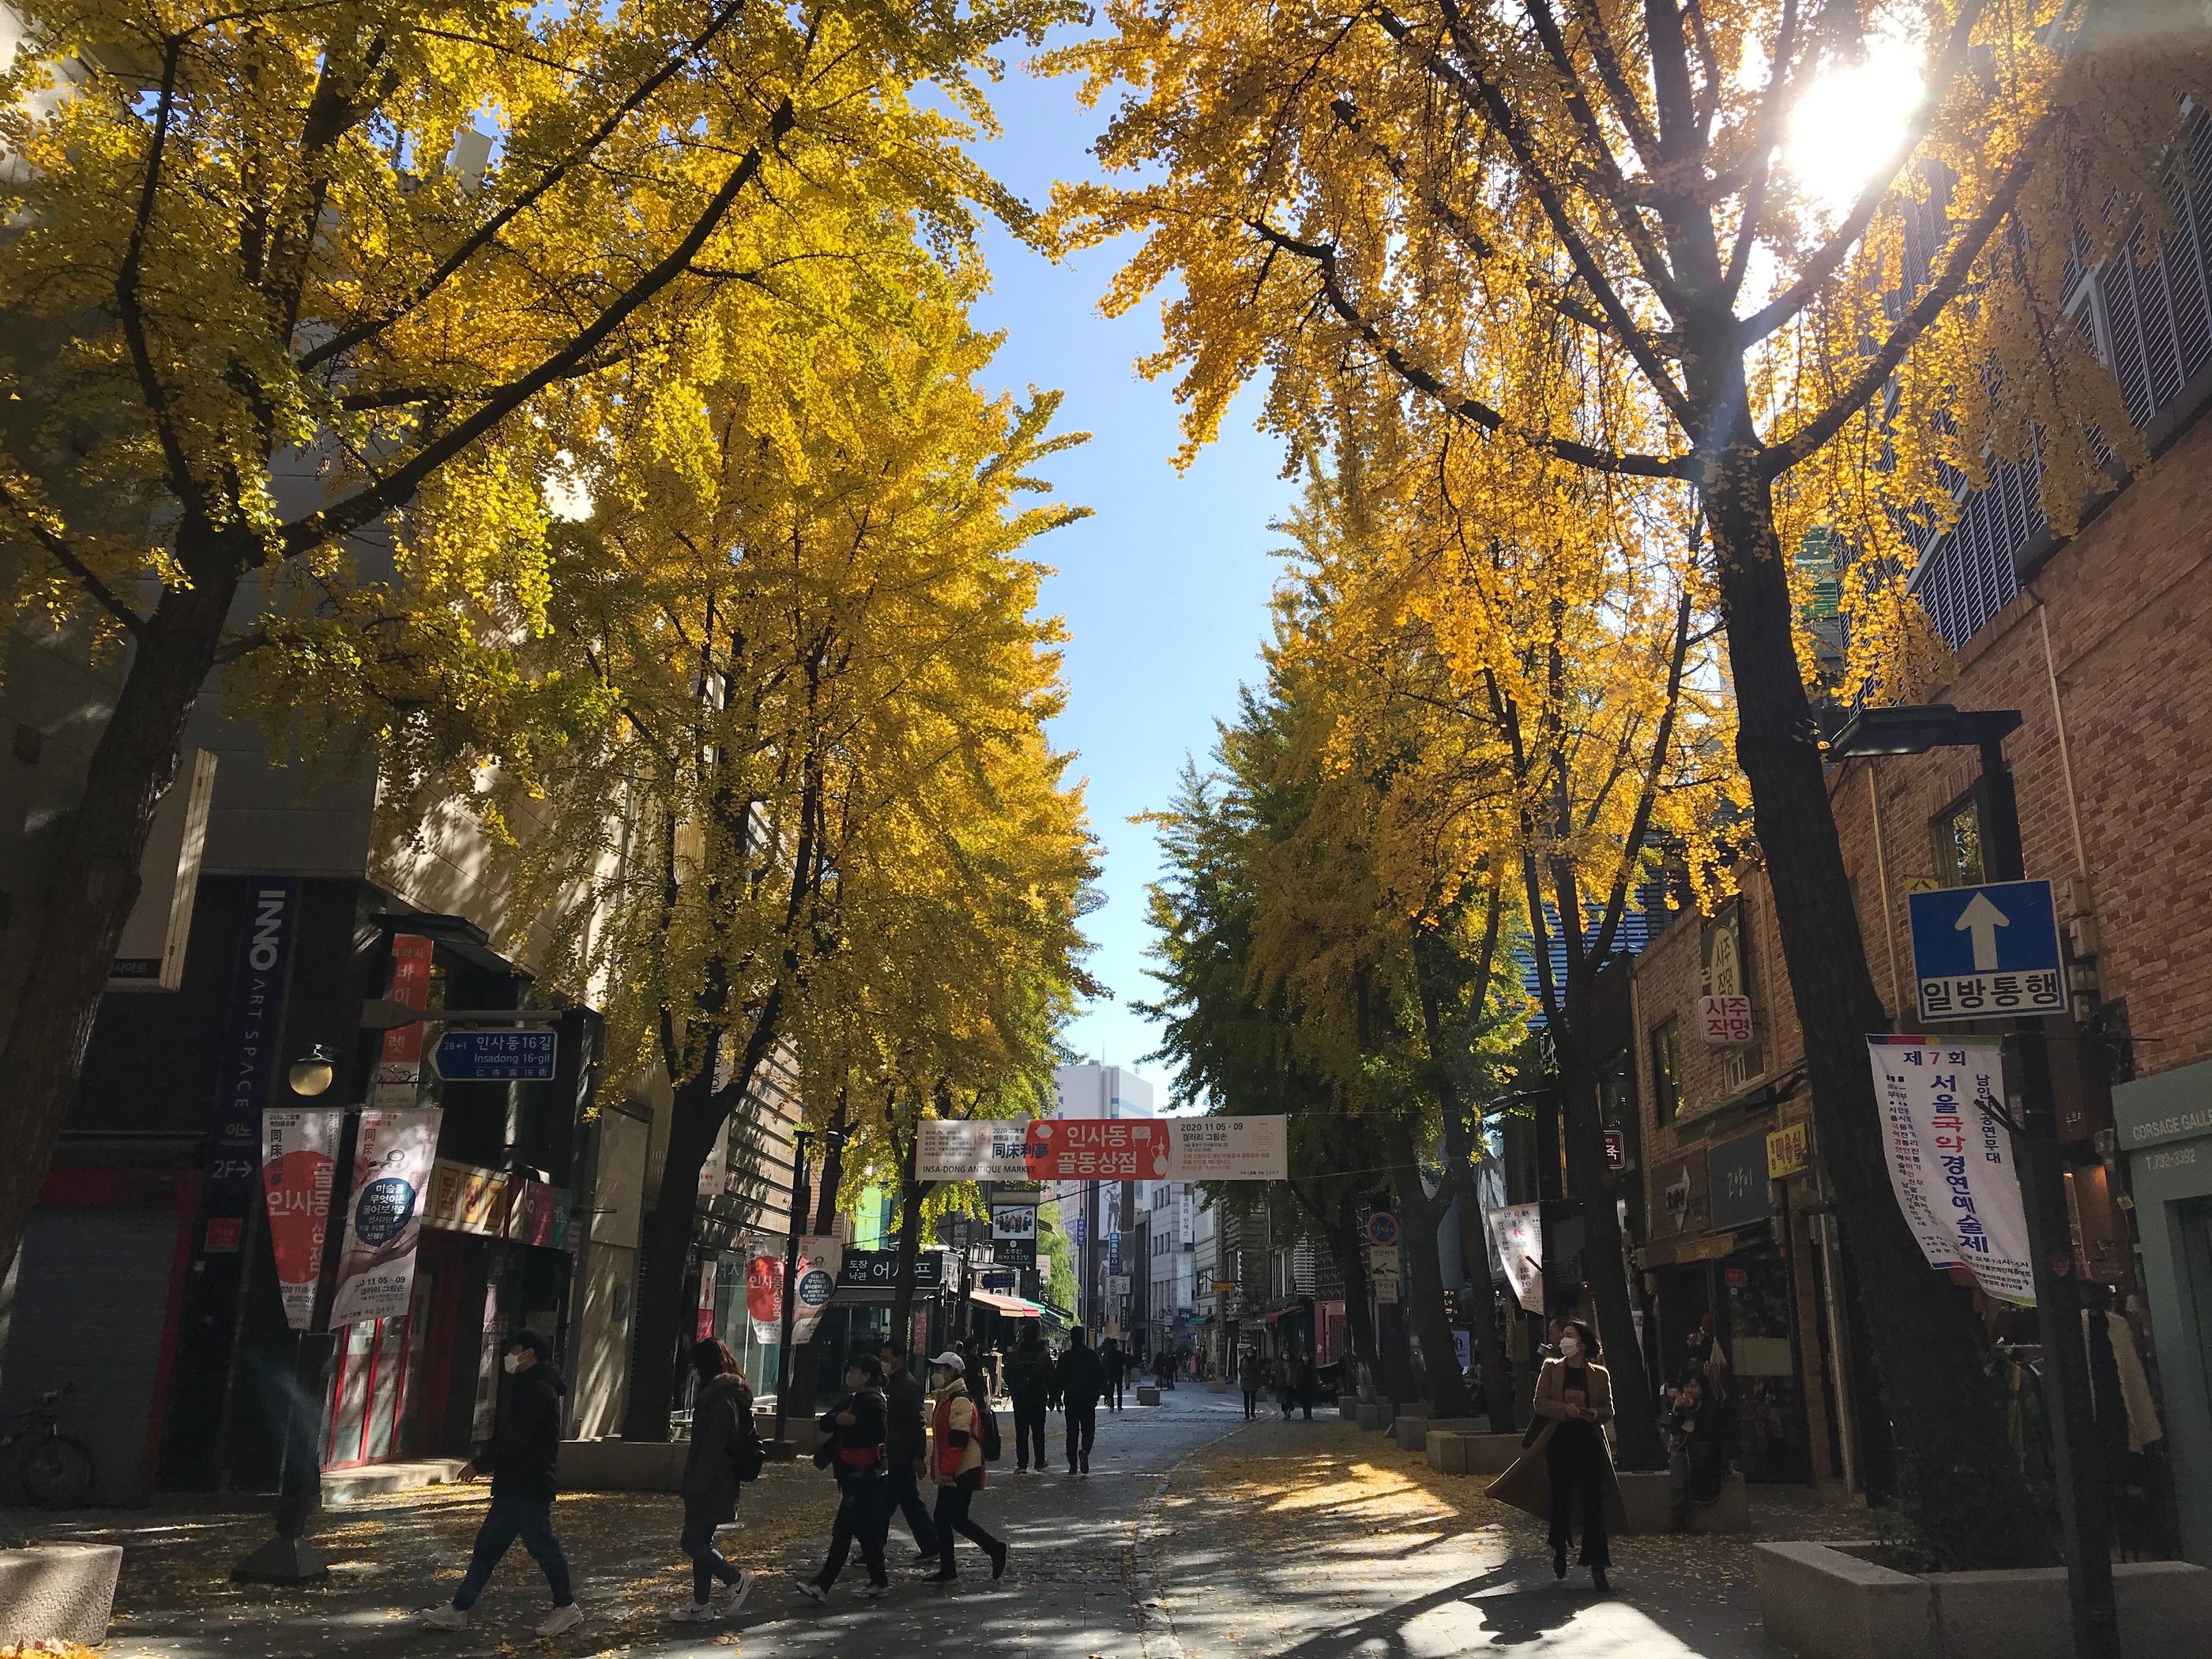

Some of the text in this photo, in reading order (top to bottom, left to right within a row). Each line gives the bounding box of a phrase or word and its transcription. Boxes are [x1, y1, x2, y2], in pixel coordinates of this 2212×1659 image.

[114, 961, 148, 973] 사아트
[235, 890, 285, 1107] INNO ART SPACE
[1923, 973, 2059, 1012] 일방통행
[1706, 998, 1747, 1017] 사주
[1707, 1018, 1749, 1040] 작명
[476, 1036, 551, 1051] 인사동16길
[475, 1054, 550, 1064] Insadong 16-gil
[1977, 1074, 2001, 1164] 남인공연무대
[1066, 1125, 1127, 1147] 인사동
[2133, 1117, 2180, 1141] CORSAGE
[212, 1160, 236, 1179] 2F
[923, 1165, 965, 1174] INSA-DONG
[1056, 1151, 1138, 1174] 골동상점
[1930, 1074, 1989, 1254] 서울국악경연예술제
[370, 1194, 404, 1204] 무엇이든
[848, 1260, 867, 1270] 도장
[873, 1262, 933, 1280] 어프
[848, 1272, 867, 1281] 낙관
